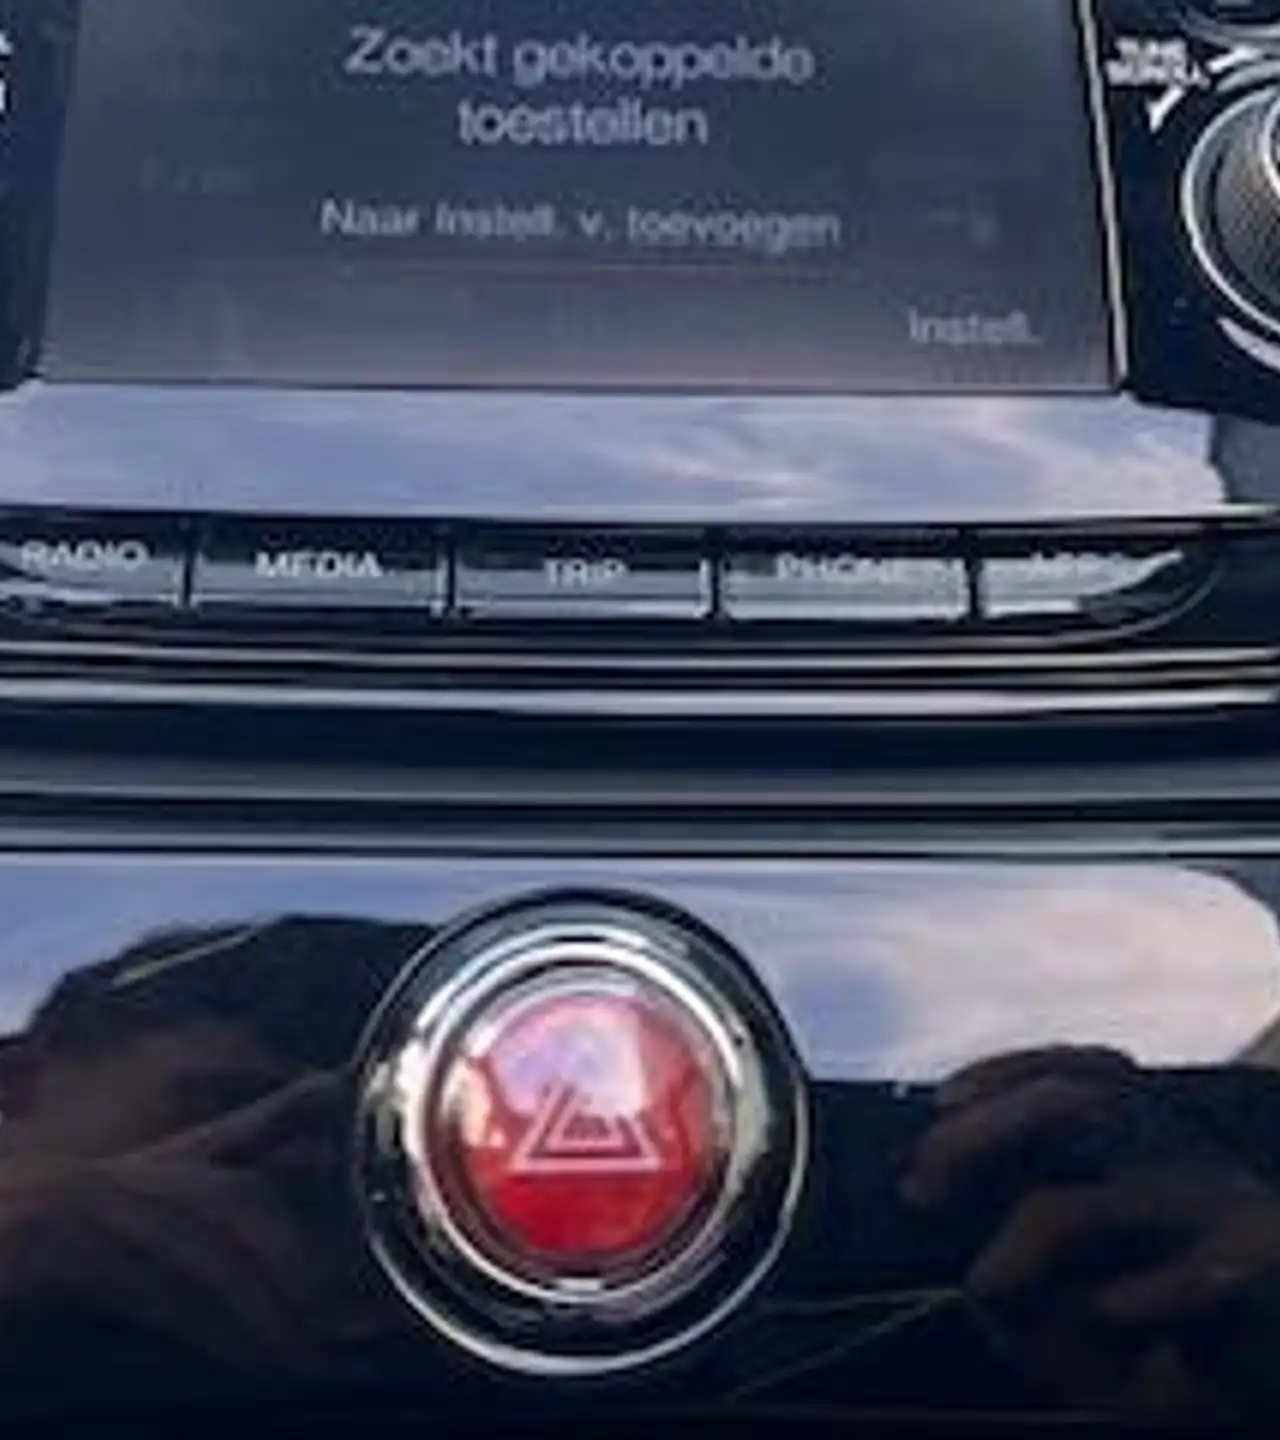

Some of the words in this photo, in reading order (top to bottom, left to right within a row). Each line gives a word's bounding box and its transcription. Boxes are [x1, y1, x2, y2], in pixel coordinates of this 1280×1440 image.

[344, 25, 499, 77] Zoekt
[512, 34, 816, 90] gekoppelde
[457, 97, 711, 146] toestellen
[321, 198, 421, 237] Naar
[20, 540, 150, 571] RADIO
[255, 553, 384, 578] MEDIA
